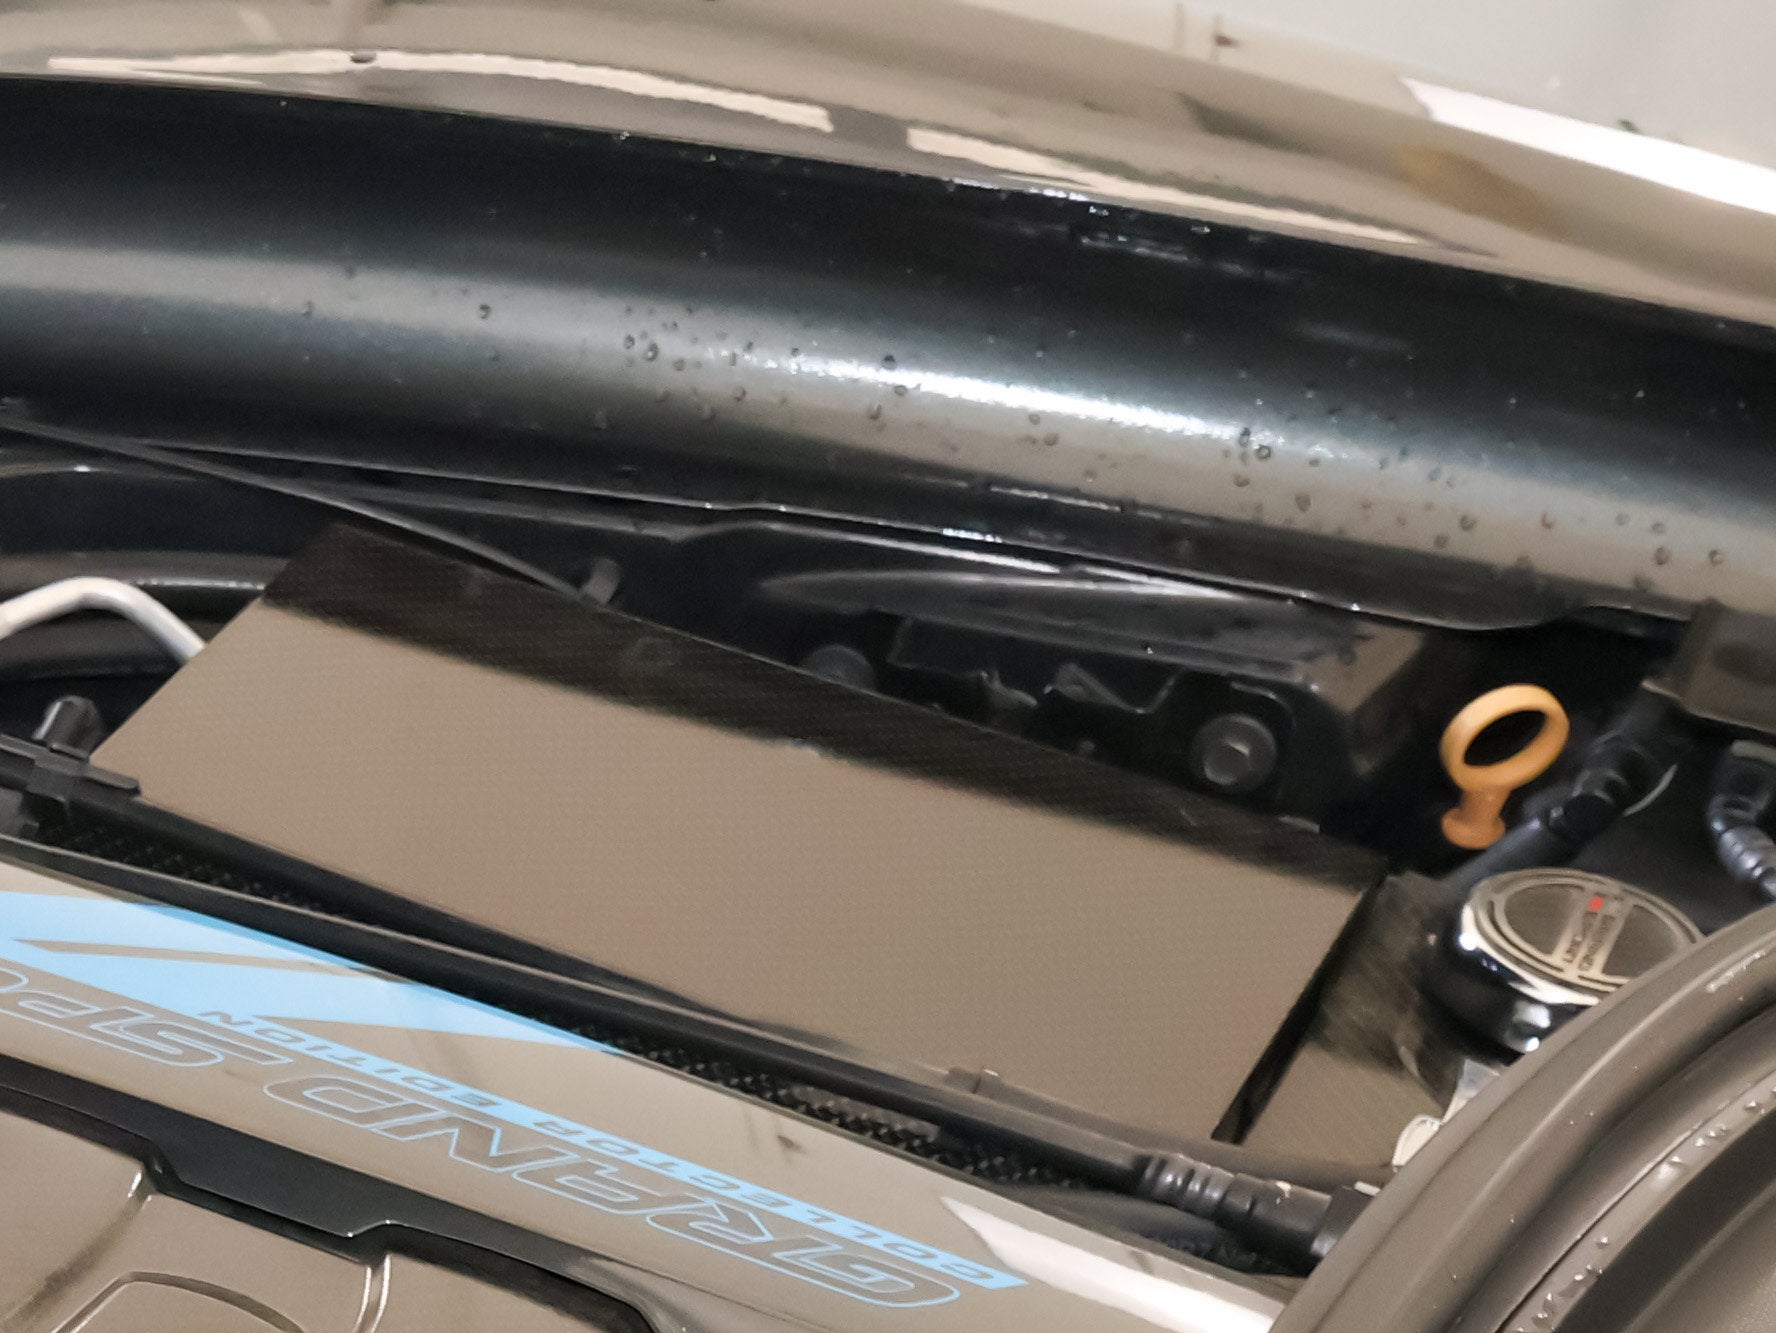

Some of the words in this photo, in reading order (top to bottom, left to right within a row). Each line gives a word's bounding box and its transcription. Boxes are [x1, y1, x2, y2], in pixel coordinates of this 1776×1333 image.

[198, 1009, 503, 1109] EDITION
[263, 1074, 960, 1307] GRAND
[540, 1118, 995, 1283] COLLECTOR
